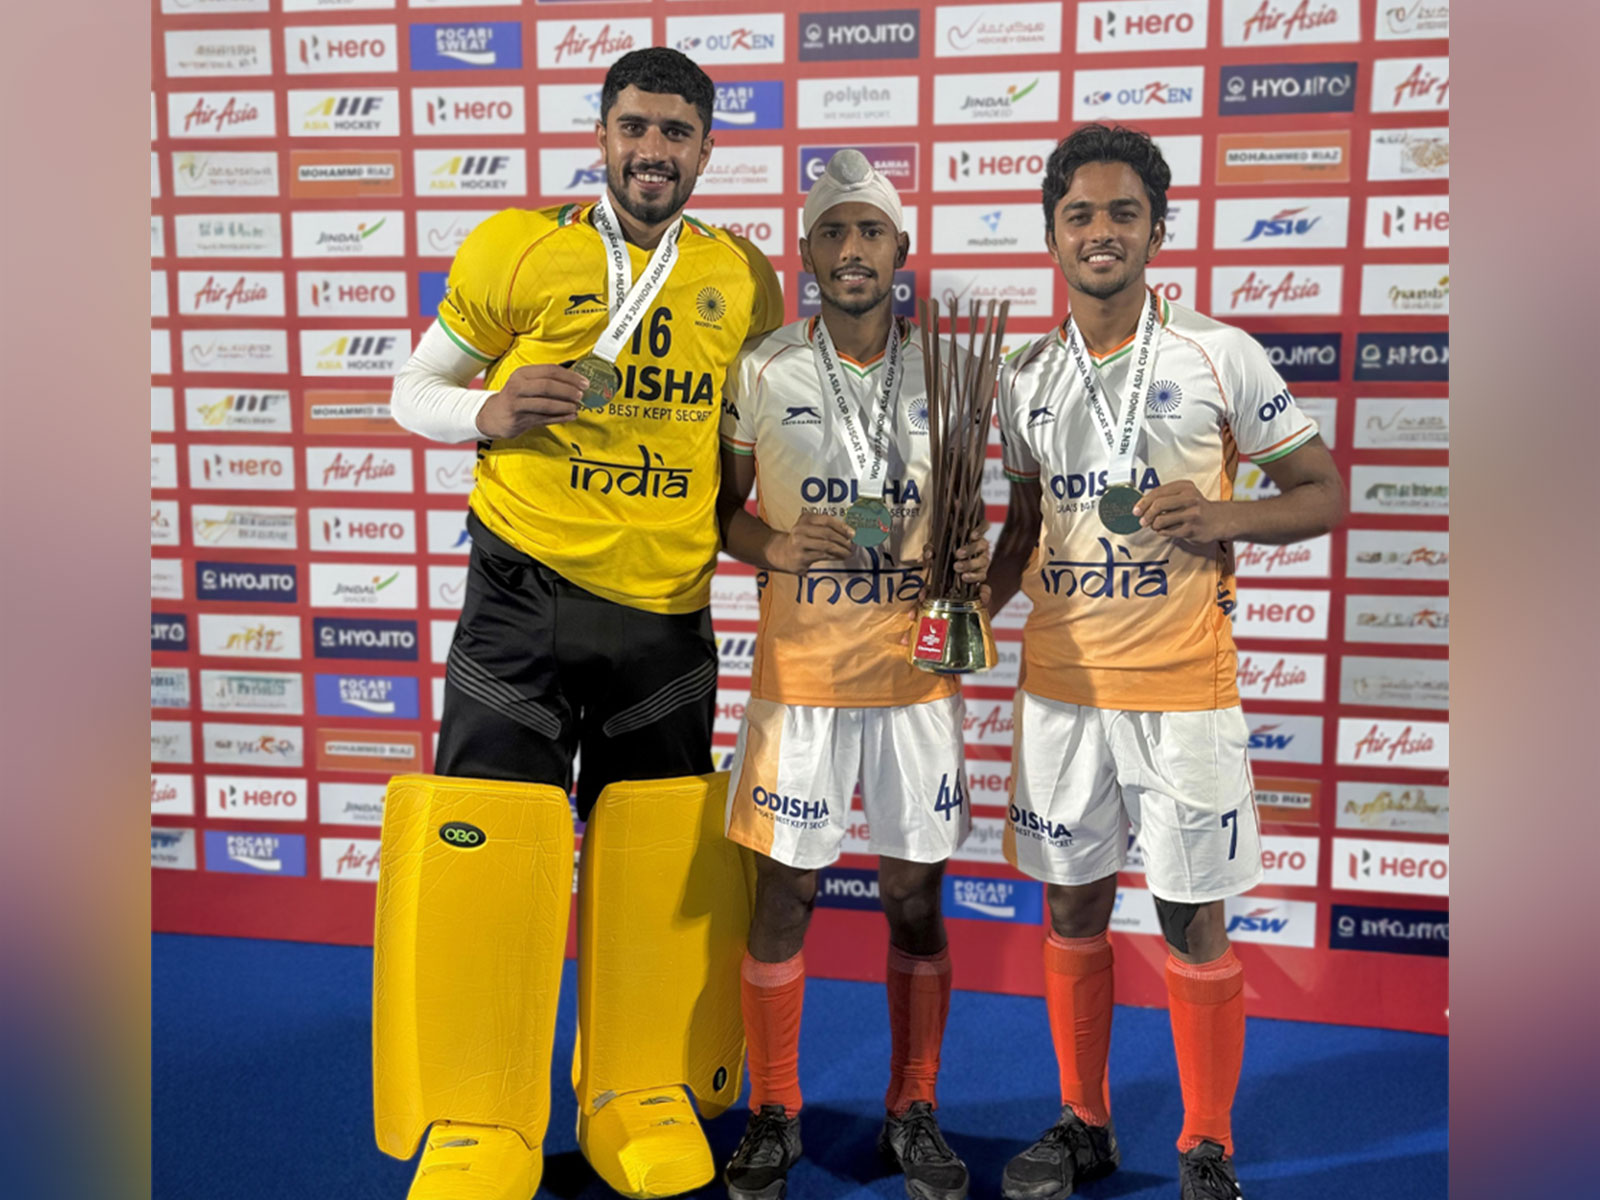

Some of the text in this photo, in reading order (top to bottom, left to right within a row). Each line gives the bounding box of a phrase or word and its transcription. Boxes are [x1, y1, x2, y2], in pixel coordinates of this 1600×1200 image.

[1126, 13, 1194, 34] Hero
[1244, 0, 1337, 40] AirAsia
[436, 28, 493, 39] POCARI
[706, 29, 774, 50] OUKEN
[829, 23, 915, 45] HYOJITO
[327, 39, 385, 58] Hero
[437, 39, 488, 50] SWEAT
[554, 24, 634, 63] AirAsia
[717, 87, 753, 99] CARI
[823, 86, 890, 106] polytan
[1117, 82, 1193, 105] OUKEN
[454, 101, 512, 120] Hero
[961, 96, 1011, 110] JINDAL
[184, 96, 258, 132] AirAsia
[334, 121, 381, 130] HOCKEY
[979, 155, 1043, 175] Hero
[461, 180, 507, 189] HOCKEY
[316, 232, 360, 244] JINDAL
[1242, 216, 1322, 242] JSW
[967, 236, 1017, 246] mubashir
[195, 276, 267, 310] AirAsia
[339, 284, 395, 302] Hero
[628, 282, 654, 316] JUNIOR
[1231, 271, 1321, 309] AirAsia
[347, 360, 394, 370] HOCKEY
[1138, 346, 1150, 366] CUP
[1133, 368, 1146, 390] ASIA
[608, 403, 640, 418] BEST
[642, 405, 673, 421] KEPT
[1125, 391, 1140, 426] JUNIOR
[836, 396, 849, 415] CUP
[843, 415, 863, 453] MUSCAT
[229, 460, 282, 476] Hero
[323, 452, 396, 487] AirAsia
[569, 443, 692, 498] india
[801, 477, 921, 504] ODIHA
[1050, 467, 1161, 500] ODISA
[349, 522, 404, 540] Hero
[1041, 537, 1169, 598] india
[220, 573, 294, 590] HYOJITO
[333, 583, 375, 595] JINDAL
[1247, 604, 1315, 623] Hero
[339, 630, 415, 648] HYOJITO
[339, 679, 392, 690] POCARI
[340, 690, 387, 700] SWEAT
[1248, 735, 1295, 750] SW
[1355, 724, 1434, 760] AirAsia
[244, 790, 297, 807] Hero
[752, 785, 830, 820] ODISHA
[934, 768, 963, 821] 44
[227, 836, 279, 849] POCARI
[1221, 809, 1238, 861] 7
[228, 848, 273, 857] SWEAT
[1261, 851, 1306, 871] ero
[1380, 856, 1448, 879] Hero
[954, 880, 1014, 894] POCARI
[955, 893, 1007, 904] SWEAT
[1226, 917, 1289, 933] JSW
